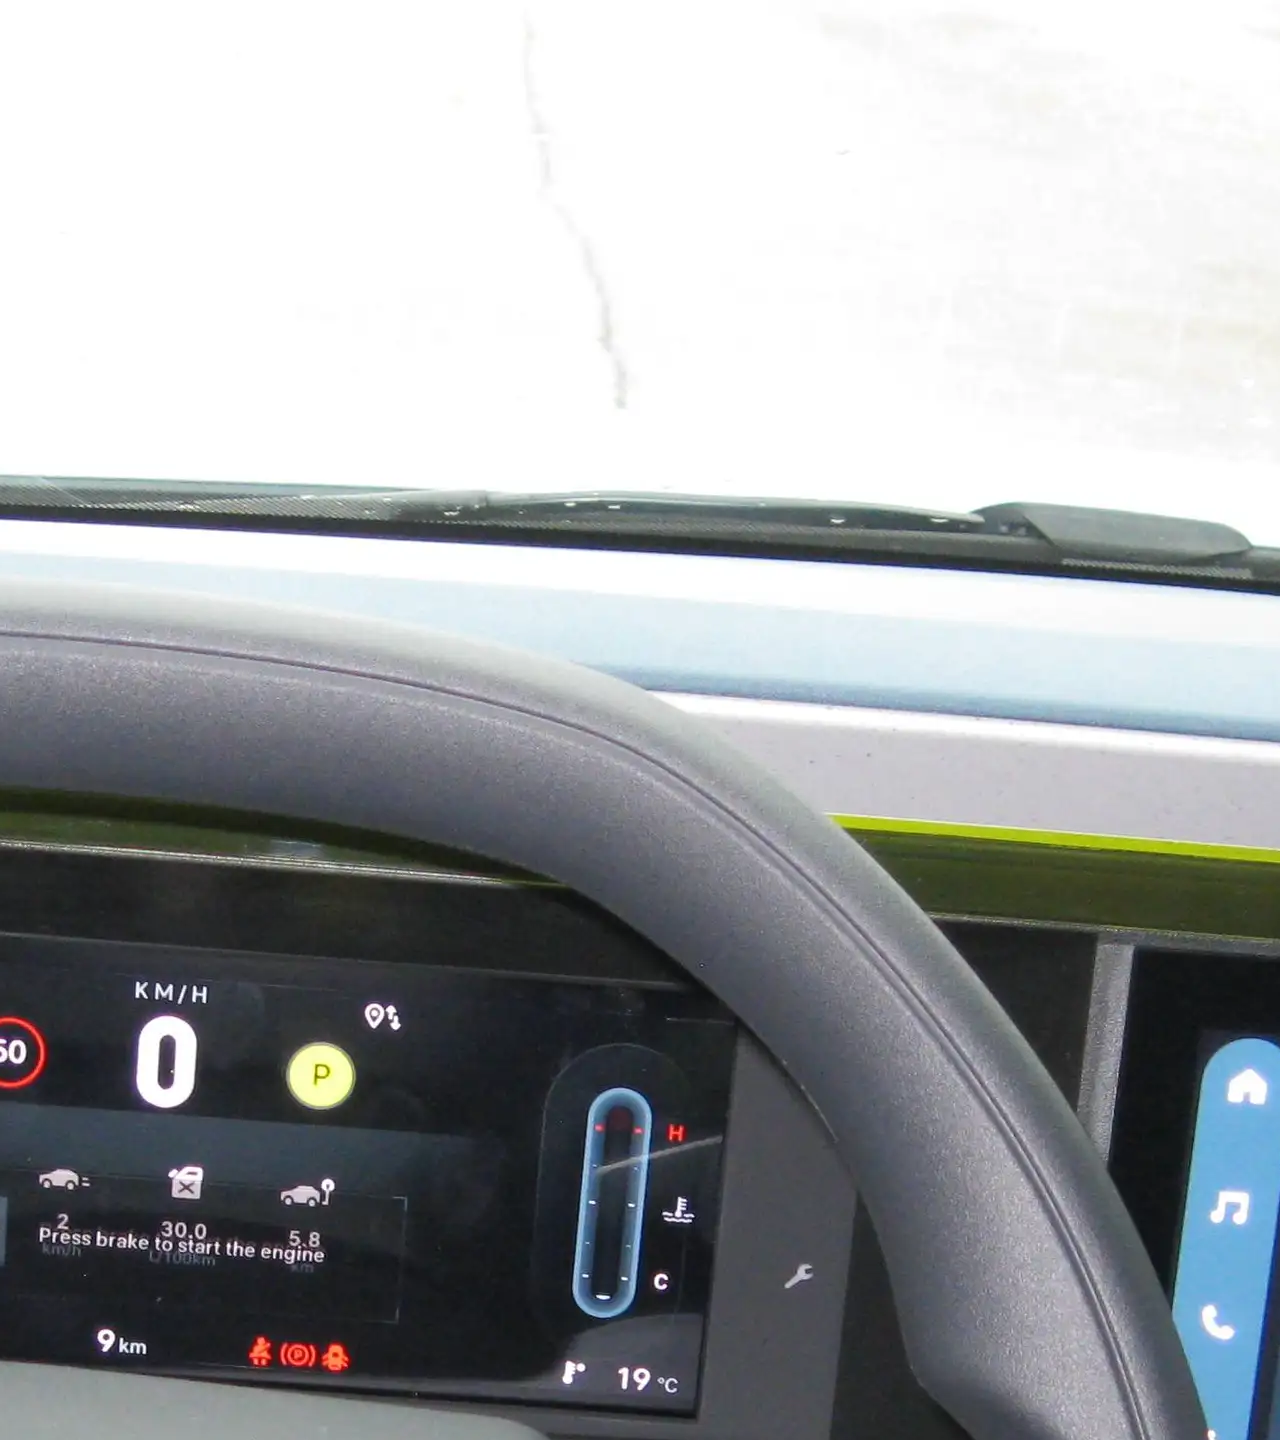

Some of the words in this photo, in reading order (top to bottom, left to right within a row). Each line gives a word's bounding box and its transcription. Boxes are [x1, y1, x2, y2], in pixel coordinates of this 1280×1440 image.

[134, 981, 208, 1005] KM/H
[136, 1015, 198, 1109] 0
[314, 1063, 331, 1087] P
[667, 1123, 685, 1142] H
[57, 1213, 69, 1230] 2
[161, 1220, 207, 1240] 30.0
[39, 1226, 91, 1246] Press
[96, 1230, 149, 1250] brake
[155, 1236, 173, 1252] to
[178, 1238, 221, 1256] start
[226, 1241, 255, 1258] the
[261, 1246, 325, 1264] engine
[653, 1272, 669, 1291] C
[96, 1328, 116, 1353] 9
[119, 1338, 147, 1355] km
[618, 1366, 651, 1391] 19
